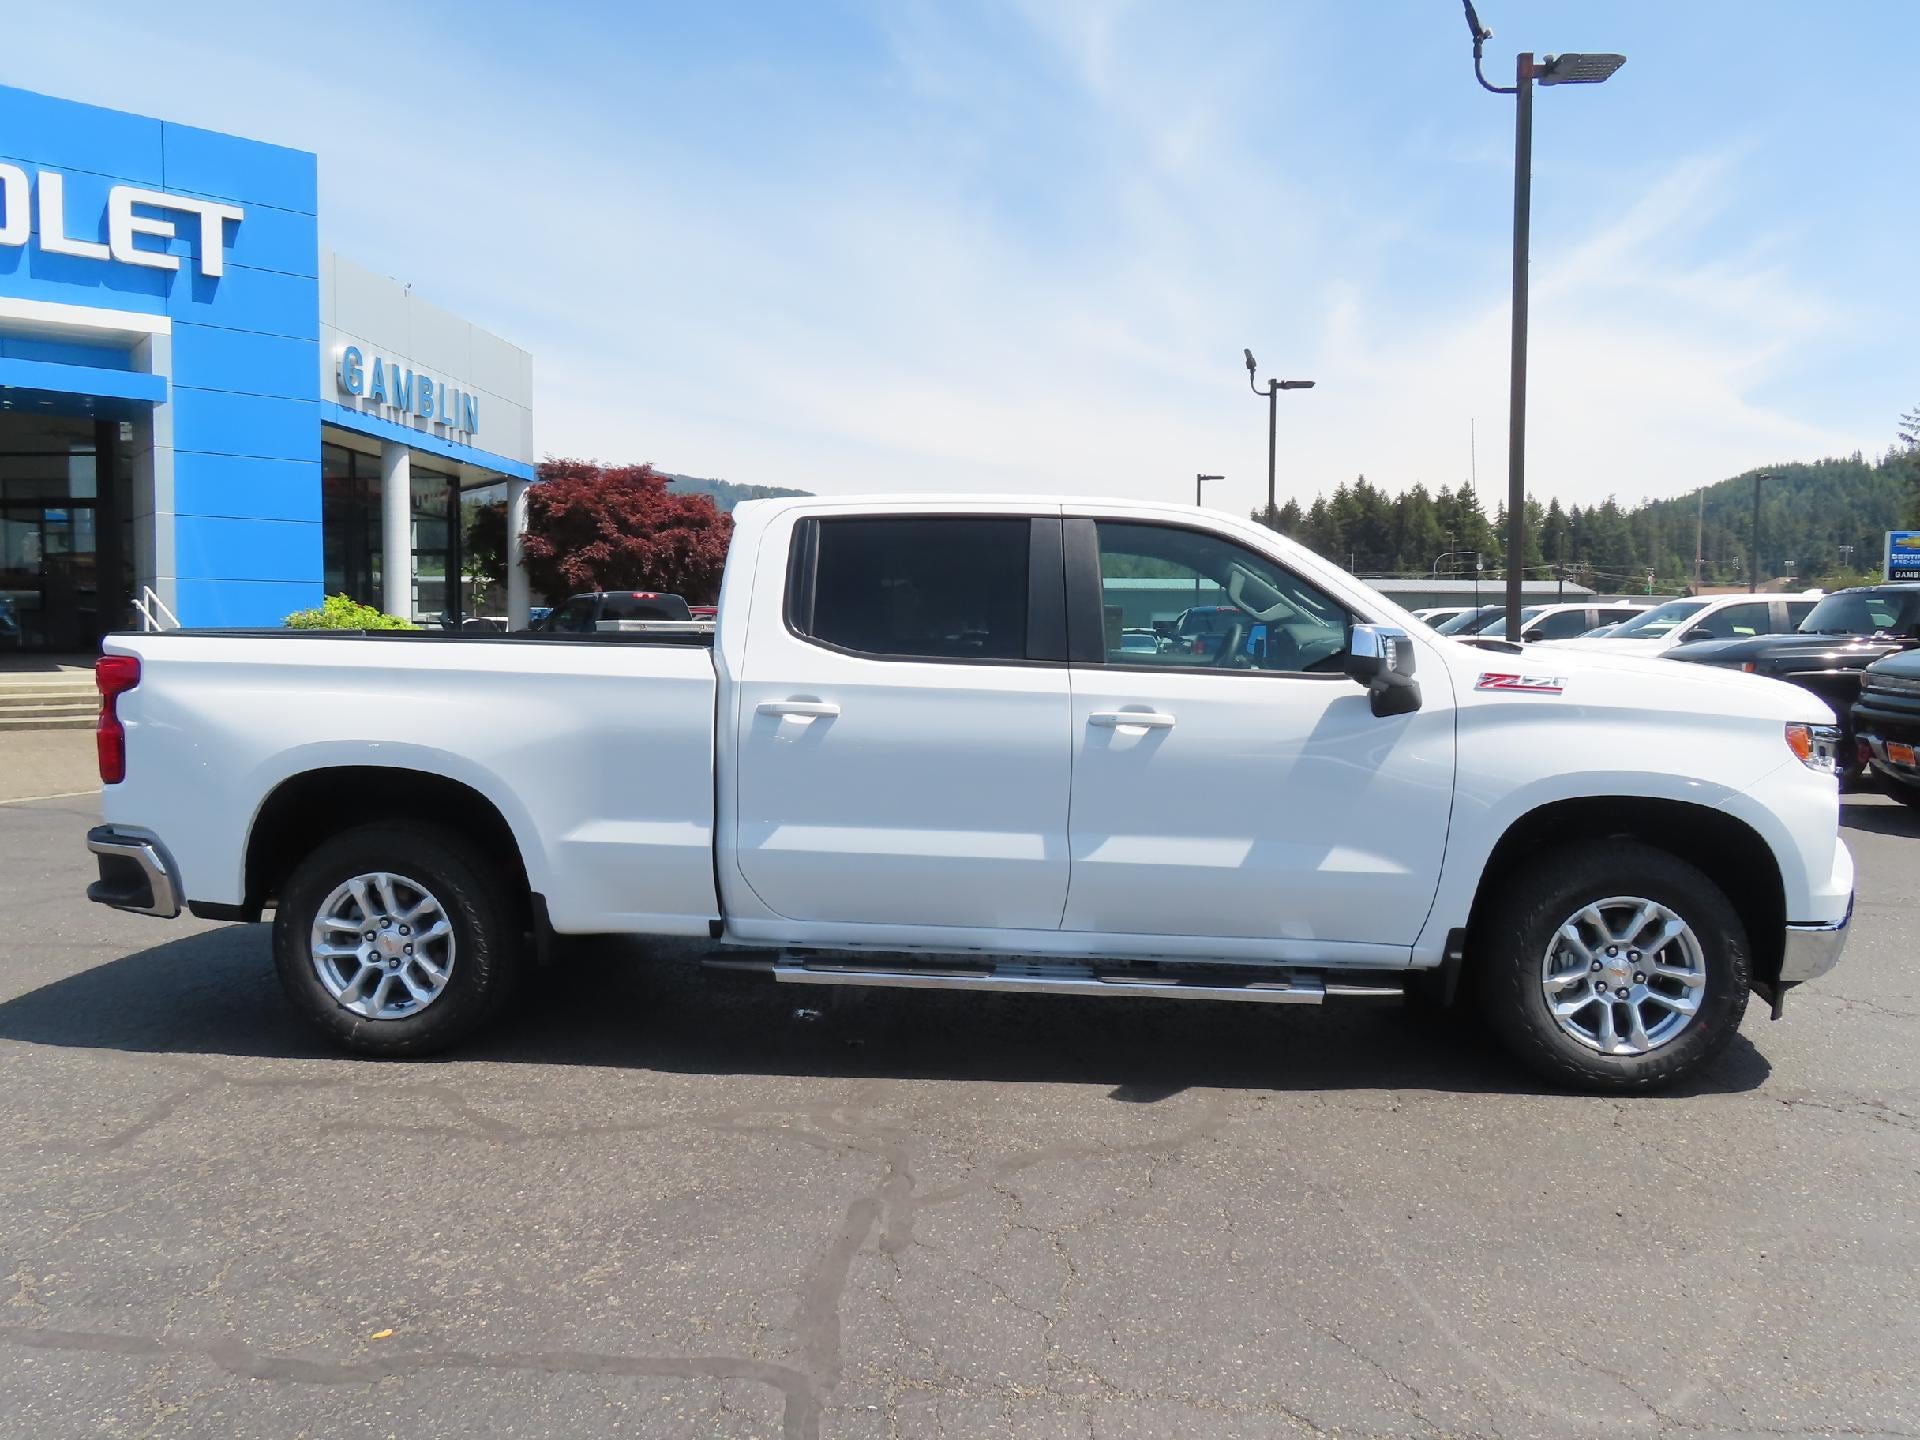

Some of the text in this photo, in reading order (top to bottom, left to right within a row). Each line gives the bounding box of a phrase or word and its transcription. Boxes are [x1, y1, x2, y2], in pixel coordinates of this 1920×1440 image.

[337, 345, 478, 435] GAMBLIN
[1895, 571, 1920, 579] GAMB
[1475, 672, 1567, 695] Z71
